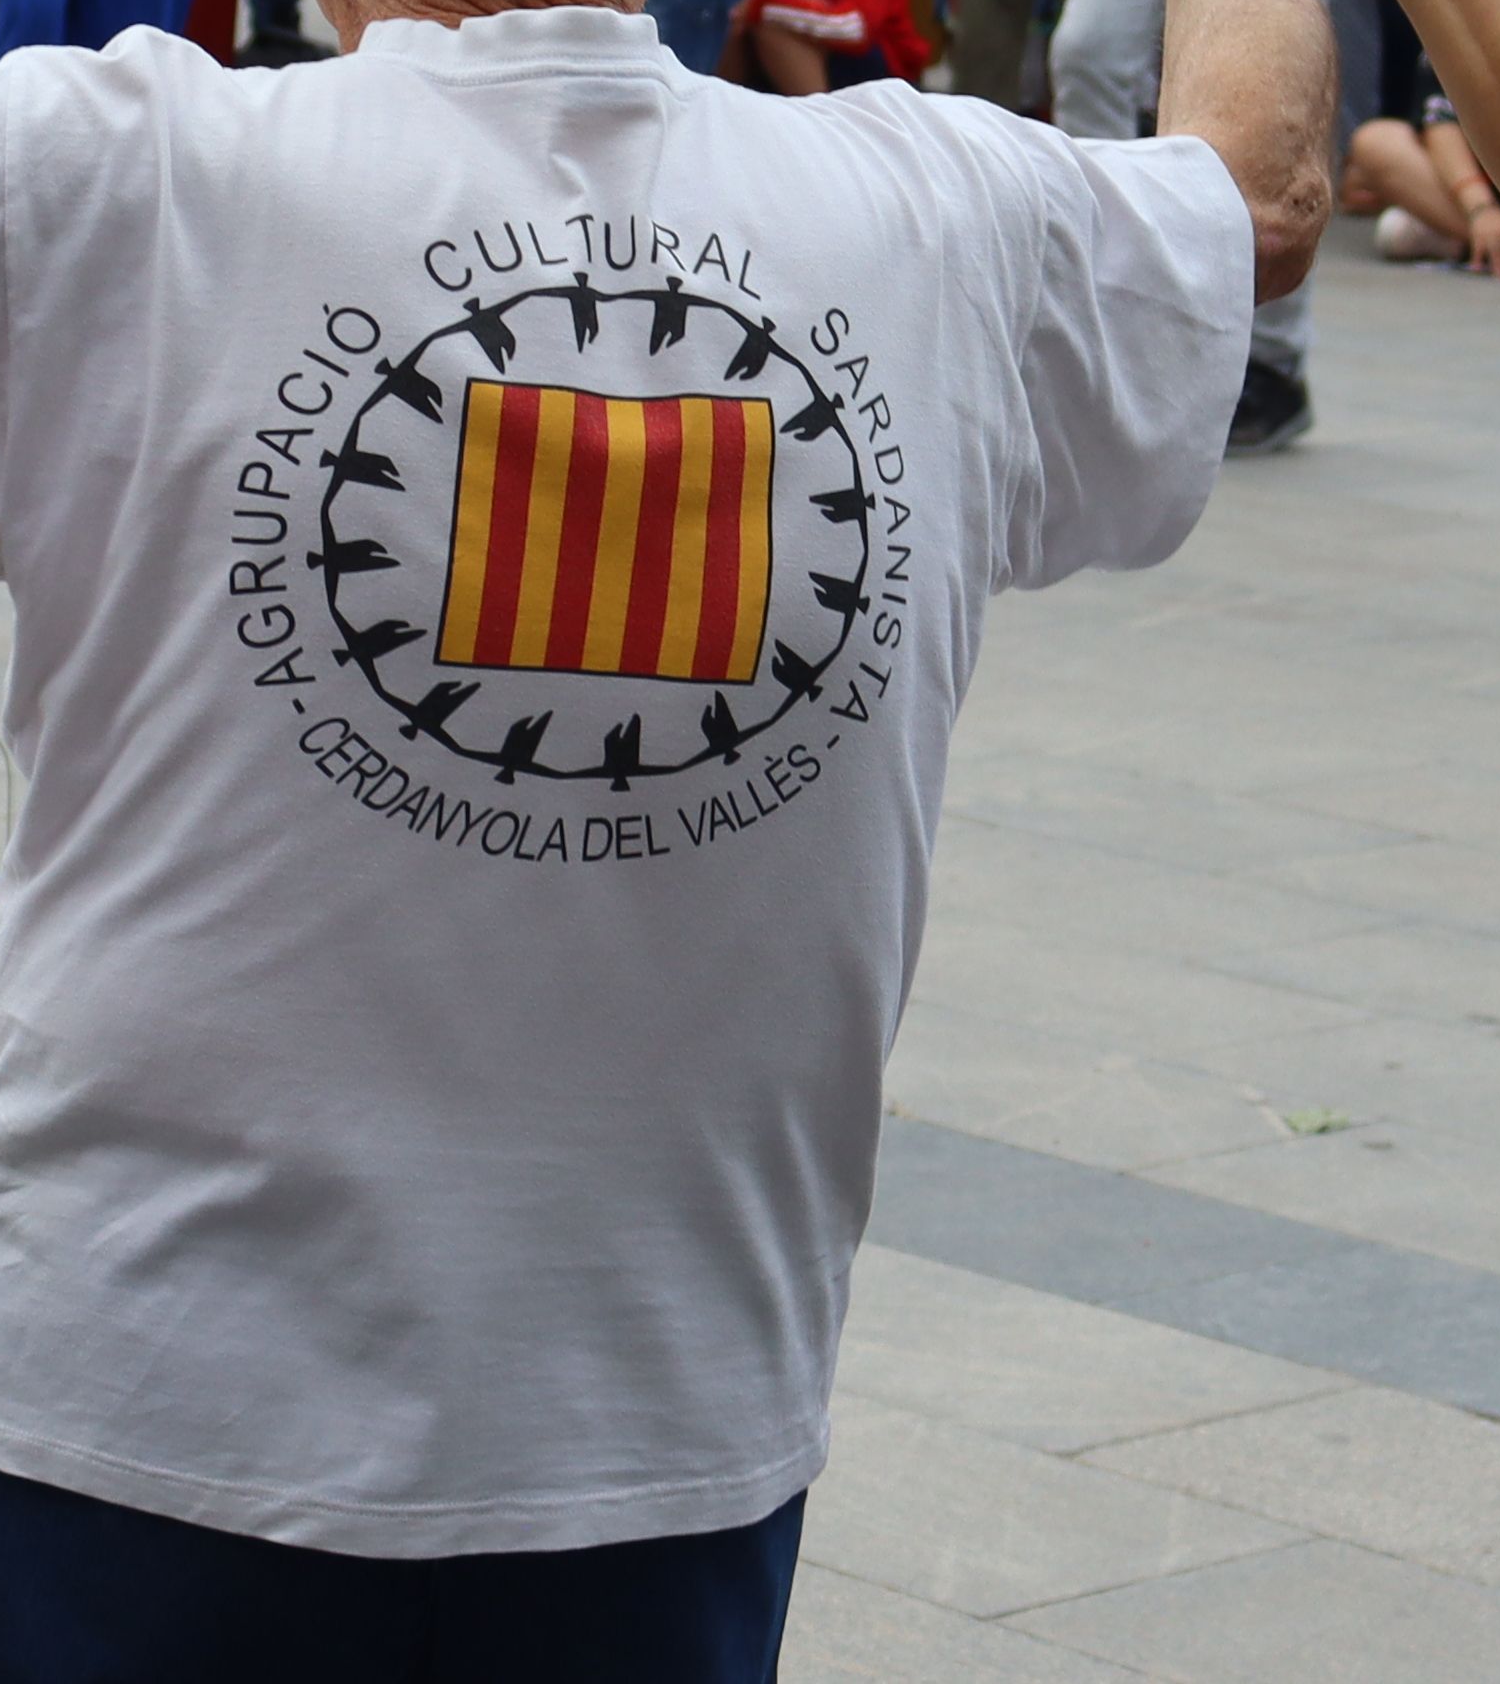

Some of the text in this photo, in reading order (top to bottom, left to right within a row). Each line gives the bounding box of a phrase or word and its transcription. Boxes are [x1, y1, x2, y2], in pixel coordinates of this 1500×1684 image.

[229, 214, 912, 725] AGRUPACIÓ CULTURAL SARDANISTA
[298, 717, 568, 863] CERDANYOLA
[581, 814, 671, 862] DEL
[678, 753, 822, 848] VALLÈS
